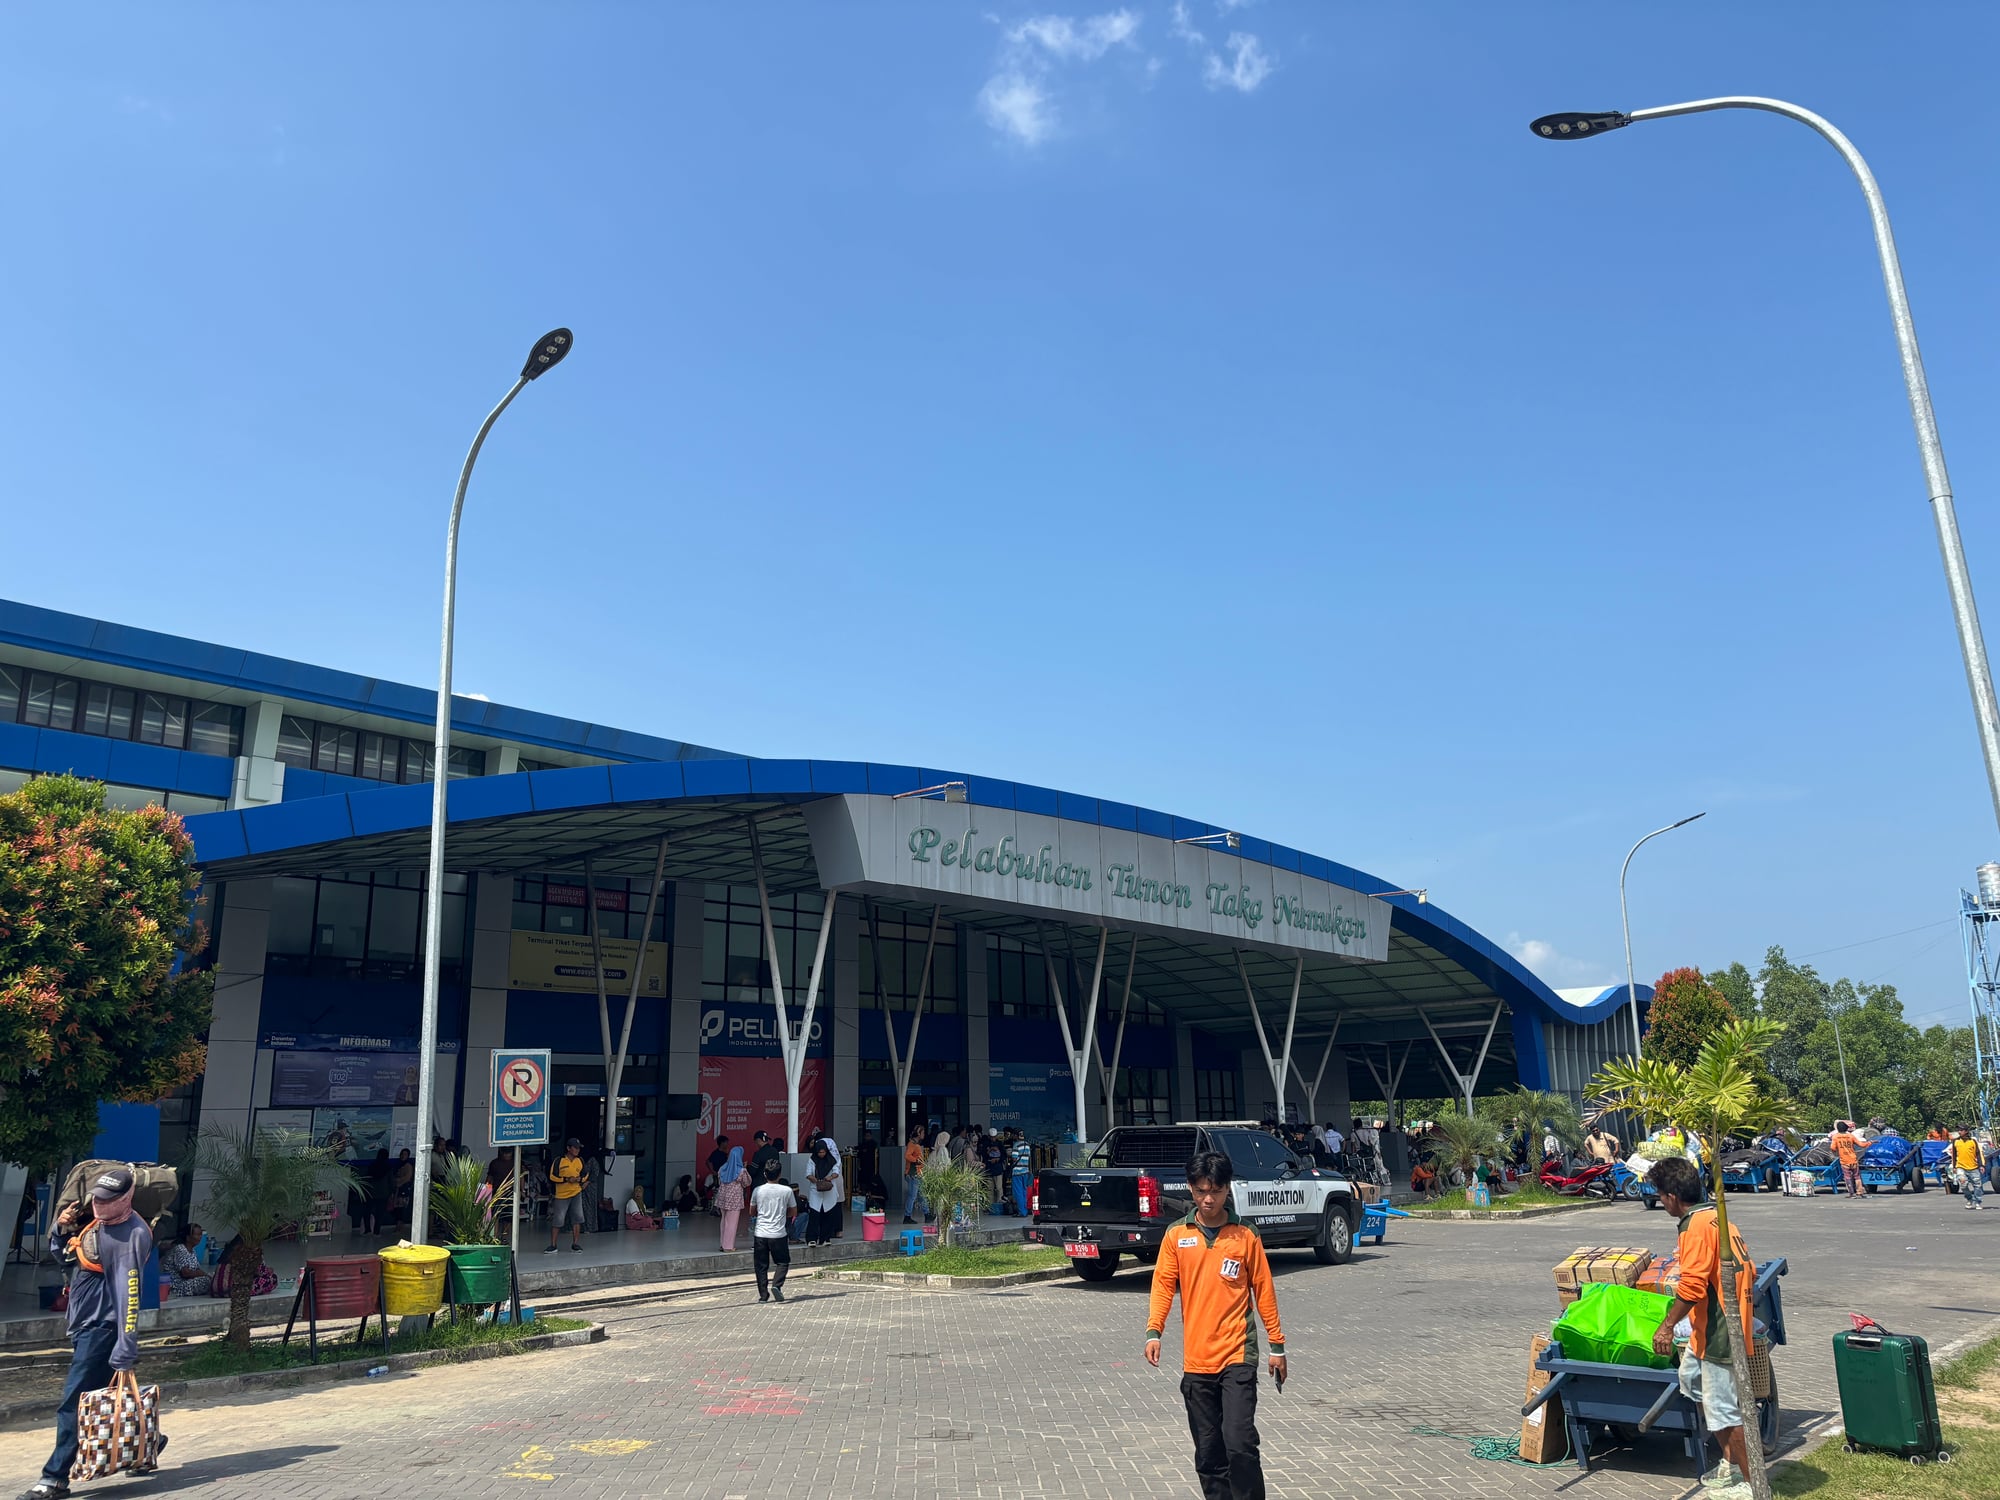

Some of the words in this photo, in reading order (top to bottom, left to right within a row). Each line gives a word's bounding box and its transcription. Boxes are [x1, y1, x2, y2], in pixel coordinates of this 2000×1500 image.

[908, 827, 1093, 891] Pelabuhan
[1106, 862, 1193, 909] Tunon
[1205, 882, 1263, 927] Taka
[1273, 892, 1367, 944] Nunukan
[527, 936, 554, 946] Terminal
[555, 939, 570, 947] Tiket
[340, 1036, 392, 1048] INFORMASI
[332, 1072, 346, 1082] 102
[990, 1098, 1010, 1107] LAYANI
[1008, 1112, 1021, 1121] HATI
[503, 1122, 535, 1130] PENURUNAN
[502, 1129, 536, 1137] PENUMPANG
[1248, 1190, 1305, 1207] IMMIGRATION
[1255, 1217, 1266, 1226] LAW
[1266, 1215, 1298, 1225] ENFORCEMENT
[1366, 1216, 1381, 1228] 224
[124, 1296, 139, 1333] BLUE
